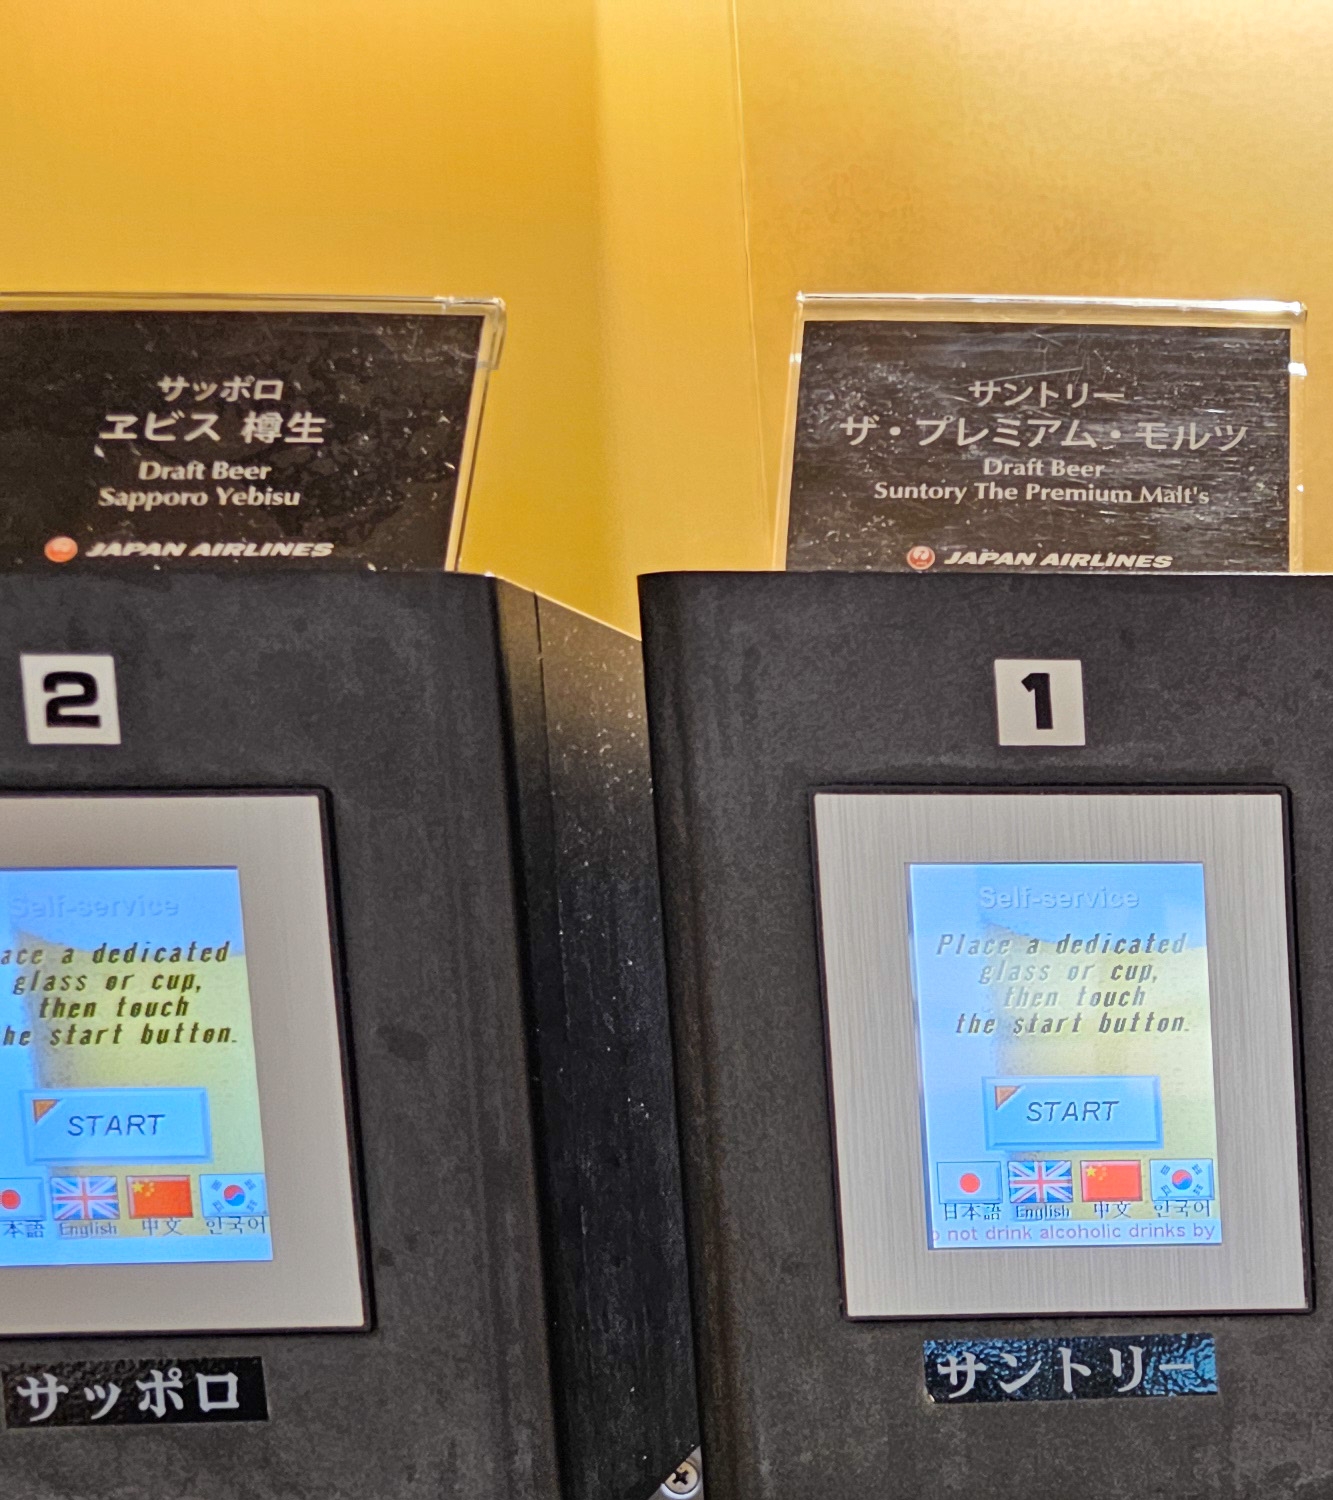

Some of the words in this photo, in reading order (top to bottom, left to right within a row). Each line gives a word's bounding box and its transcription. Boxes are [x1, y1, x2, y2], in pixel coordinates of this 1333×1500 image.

[157, 376, 284, 402] サッポロ
[968, 381, 1125, 408] サントリー
[99, 411, 221, 443] ヱビス
[241, 412, 326, 445] 樽生
[839, 417, 1248, 451] ザ・プレミアム・モルツ
[138, 462, 205, 481] Draft
[211, 462, 272, 481] Beer
[983, 458, 1047, 476] Draft
[1051, 459, 1106, 477] Beer
[98, 487, 208, 511] Sapporo
[214, 488, 301, 507] Yebisu
[873, 481, 966, 504] Suntory
[973, 482, 1017, 500] The
[1025, 482, 1133, 503] Premium
[1139, 485, 1210, 505] Malt's
[86, 542, 190, 558] JAPAN
[192, 542, 334, 558] AIRLINES
[943, 550, 1036, 566] JAPAN
[1039, 552, 1173, 569] AIRLINES
[41, 671, 100, 728] 2
[1020, 672, 1053, 730] 1
[11, 897, 179, 918] Self-service
[978, 887, 1140, 910] Self-service
[61, 948, 72, 964] a
[92, 941, 230, 964] dedicated
[936, 934, 1012, 956] Place
[1027, 939, 1039, 956] a
[1055, 932, 1187, 955] dedicated
[13, 971, 87, 995] glass
[106, 973, 135, 991] or
[151, 973, 203, 994] cup,
[978, 960, 1050, 985] glass
[1067, 964, 1095, 981] or
[1110, 963, 1158, 984] cup,
[38, 997, 97, 1019] then
[116, 996, 190, 1018] touch
[1003, 988, 1058, 1009] then
[1077, 986, 1146, 1008] touch
[50, 1024, 123, 1046] start
[140, 1024, 239, 1046] button.
[955, 1013, 995, 1035] the
[1013, 1013, 1082, 1036] start
[1099, 1011, 1191, 1034] button.
[1026, 1100, 1119, 1122] START
[67, 1114, 165, 1137] START
[944, 1201, 1001, 1220] 日本語
[1015, 1204, 1071, 1221] English
[1093, 1201, 1132, 1219] 中文
[1153, 1199, 1212, 1219] 한국어
[59, 1220, 118, 1237] English
[141, 1217, 182, 1237] 中文
[948, 1225, 978, 1241] not
[985, 1224, 1032, 1240] drink
[1040, 1224, 1120, 1239] alcoholic
[1128, 1223, 1185, 1238] drinks
[1193, 1223, 1215, 1241] by
[937, 1345, 1195, 1399] サントリー
[17, 1367, 240, 1422] サッポロ
